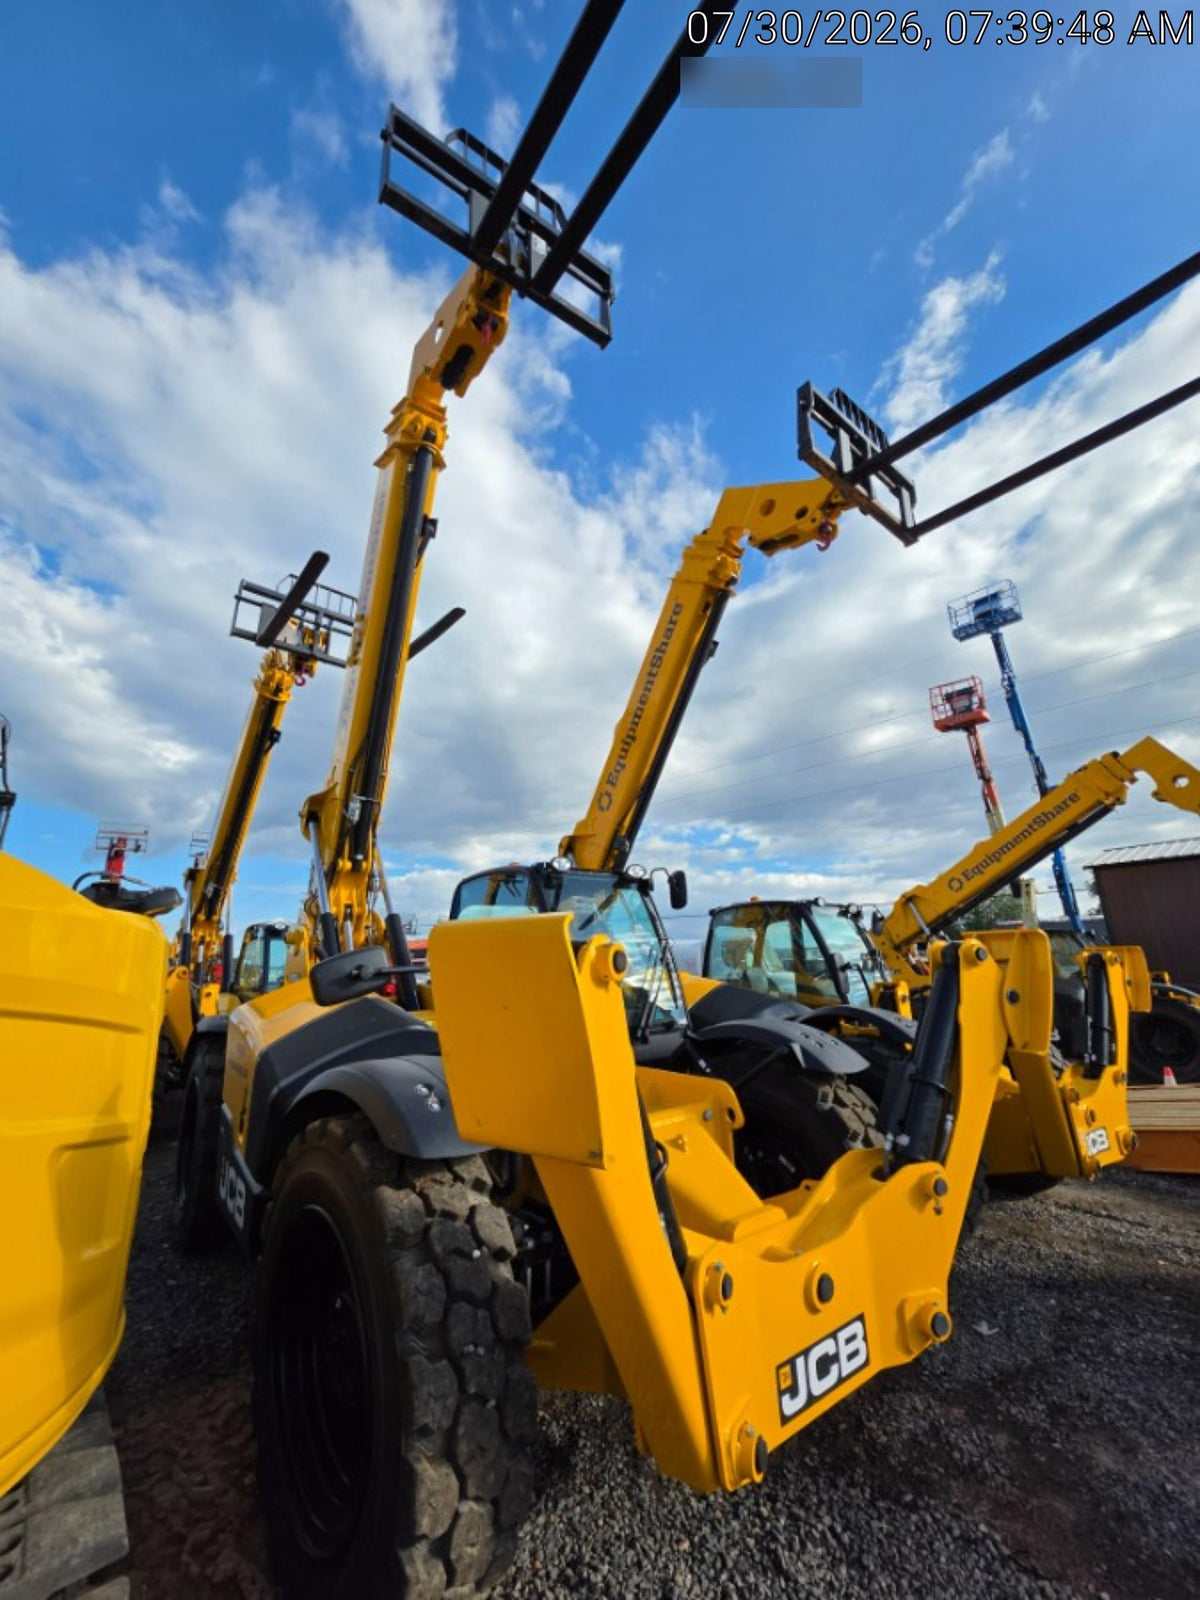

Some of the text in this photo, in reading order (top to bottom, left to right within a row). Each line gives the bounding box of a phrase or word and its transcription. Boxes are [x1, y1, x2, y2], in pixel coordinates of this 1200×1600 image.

[606, 602, 683, 788] EquipmentShare
[961, 791, 1081, 882] EquipmentShare
[781, 1319, 868, 1417] JCB
